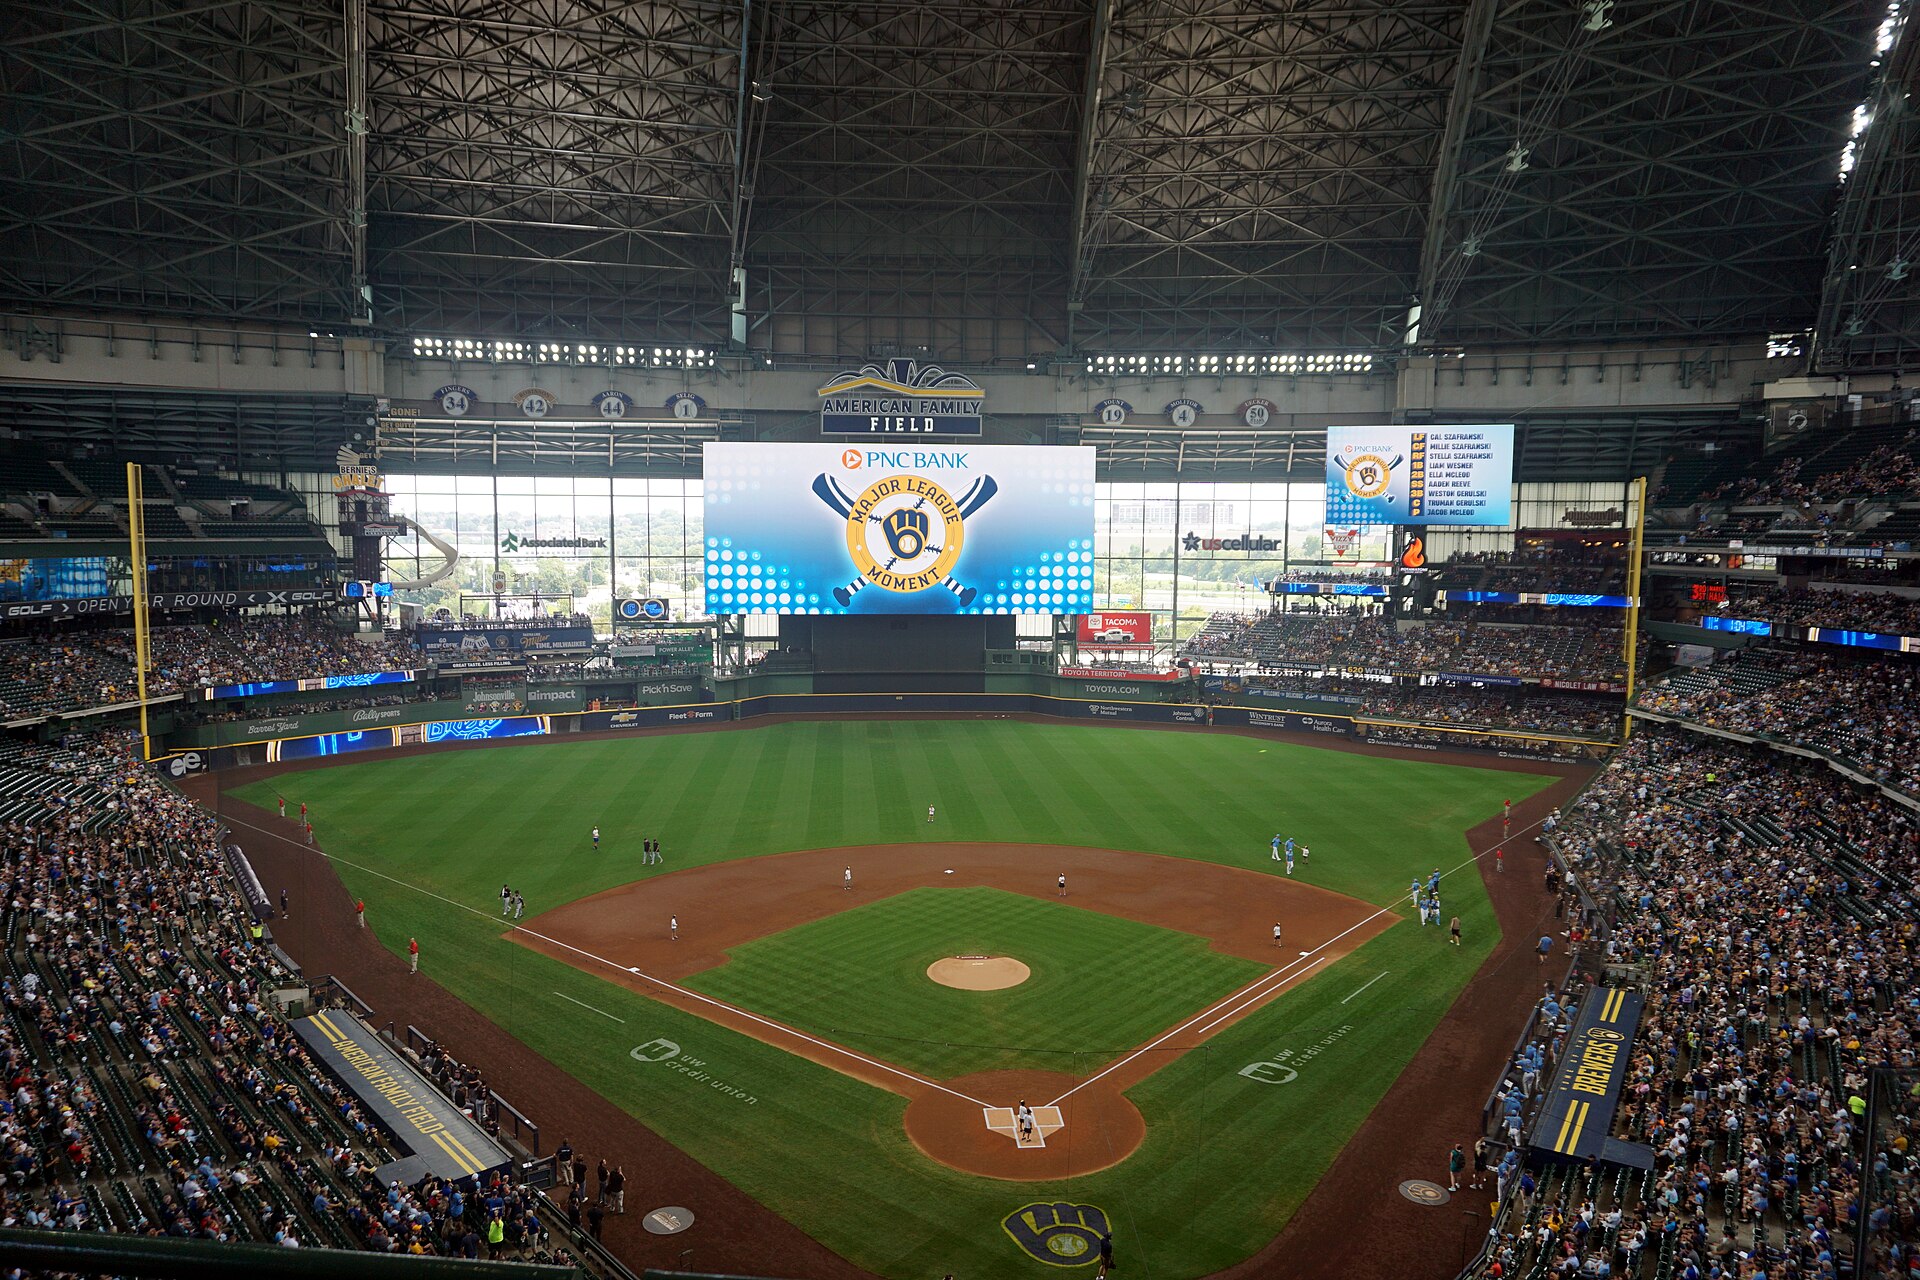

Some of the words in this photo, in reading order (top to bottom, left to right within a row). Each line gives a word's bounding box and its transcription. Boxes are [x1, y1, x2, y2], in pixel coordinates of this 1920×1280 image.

[441, 385, 470, 395] FINGERS
[601, 391, 623, 399] AARON
[446, 396, 465, 410] 34
[525, 399, 544, 413] 42
[602, 401, 622, 414] 44
[822, 399, 912, 414] AMERICAN
[919, 399, 981, 415] FAMILY
[1170, 399, 1198, 408] MOLITOR
[1244, 399, 1269, 407] UECKER
[391, 408, 421, 416] GONE!
[682, 404, 690, 417] 1
[1105, 409, 1121, 421] 19
[1179, 410, 1187, 421] 4
[1249, 408, 1264, 419] 50
[870, 417, 934, 432] FIELD
[866, 451, 910, 468] PNC
[913, 452, 969, 469] BANK
[1412, 452, 1425, 460] RF
[340, 466, 377, 474] BERNIE'S
[1348, 456, 1367, 472] MAJOR
[1369, 456, 1389, 472] LEAGUE
[332, 474, 384, 489] CHALET
[1353, 488, 1381, 497] MOMENT
[852, 479, 899, 525] MAJOR
[907, 479, 960, 525] LEAGUE
[1412, 499, 1421, 507] C
[867, 565, 943, 591] MOMENT
[292, 591, 333, 601] GOLF
[78, 599, 120, 613] OPEN
[124, 594, 163, 610] YAR
[175, 593, 237, 606] ROUND
[8, 604, 53, 616] GOLF
[1105, 618, 1138, 626] TACOMA
[1730, 620, 1746, 632] 1:04
[520, 634, 550, 648] Miller
[552, 640, 586, 648] MILWAUKEE
[1064, 669, 1090, 677] TOYOTA
[1090, 670, 1128, 679] TERRITORY
[1365, 667, 1391, 675] WTMJ
[1441, 673, 1471, 681] WINTRUST
[670, 684, 693, 693] Save
[1085, 684, 1140, 695] TOYOTA.COM
[1554, 681, 1581, 689] NICOLET
[1583, 682, 1598, 690] LAW
[473, 690, 516, 702] Johnsonville
[536, 689, 576, 701] impact
[1100, 705, 1133, 713] Northwestern
[353, 709, 381, 722] Bally
[380, 710, 401, 718] SPORTS
[669, 712, 687, 720] Fleet
[695, 711, 713, 719] Farm
[1249, 711, 1286, 722] WINTRUST
[247, 723, 276, 734] Barrel
[276, 720, 299, 733] Yard
[1291, 1045, 1325, 1067] credit
[1321, 1024, 1355, 1045] union
[681, 1054, 707, 1067] uw
[1273, 1048, 1295, 1061] uw
[1570, 1054, 1579, 1063] OF
[1572, 1040, 1619, 1096] BREWERS
[332, 1039, 388, 1081] AMERICAN
[371, 1076, 420, 1109] FAMILY
[401, 1105, 445, 1134] FIELD
[665, 1061, 711, 1082] credit
[710, 1080, 758, 1105] union
